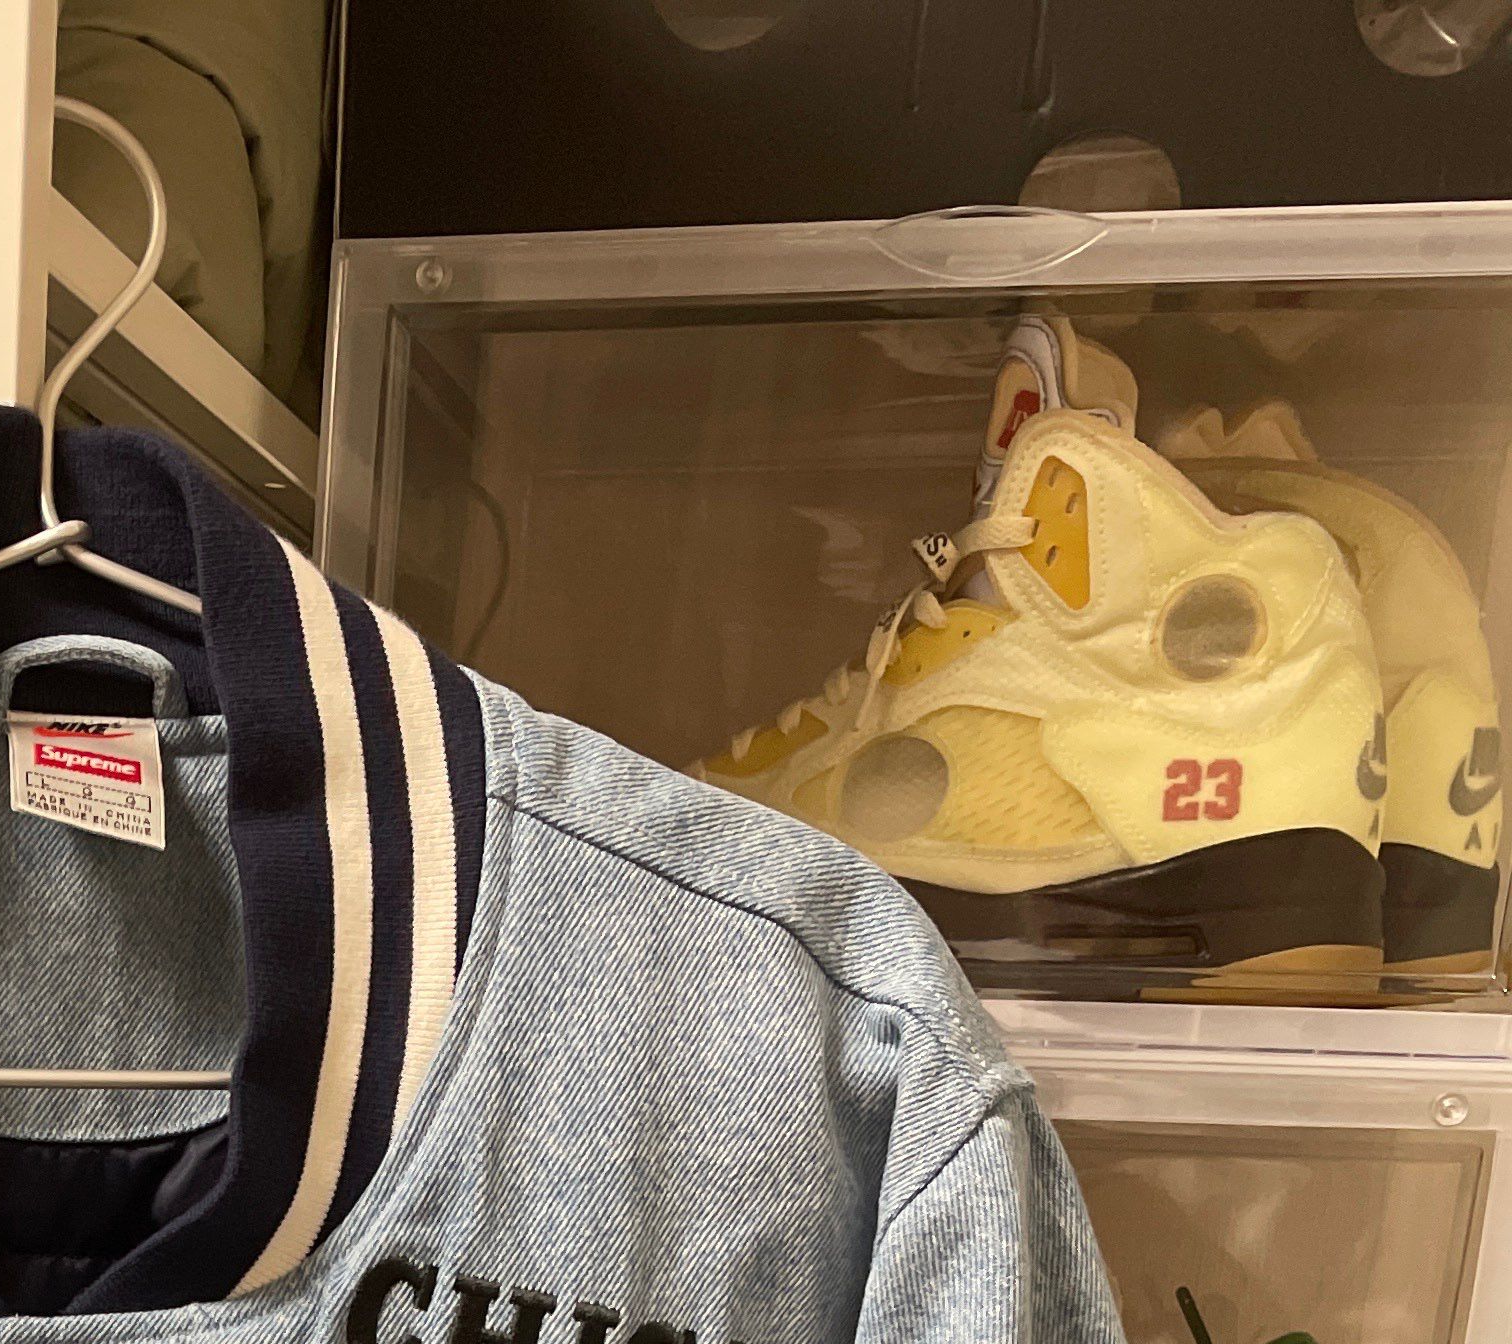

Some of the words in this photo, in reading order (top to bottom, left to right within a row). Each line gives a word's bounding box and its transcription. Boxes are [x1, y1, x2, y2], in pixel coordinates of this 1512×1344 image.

[47, 721, 110, 736] NIKE
[40, 745, 137, 776] Supreme
[27, 790, 66, 806] MADE
[106, 808, 151, 826] CHINA
[1161, 758, 1244, 822] 23
[28, 798, 88, 821] FABRIQUE
[93, 815, 109, 828] EN
[113, 819, 152, 837] CHINE
